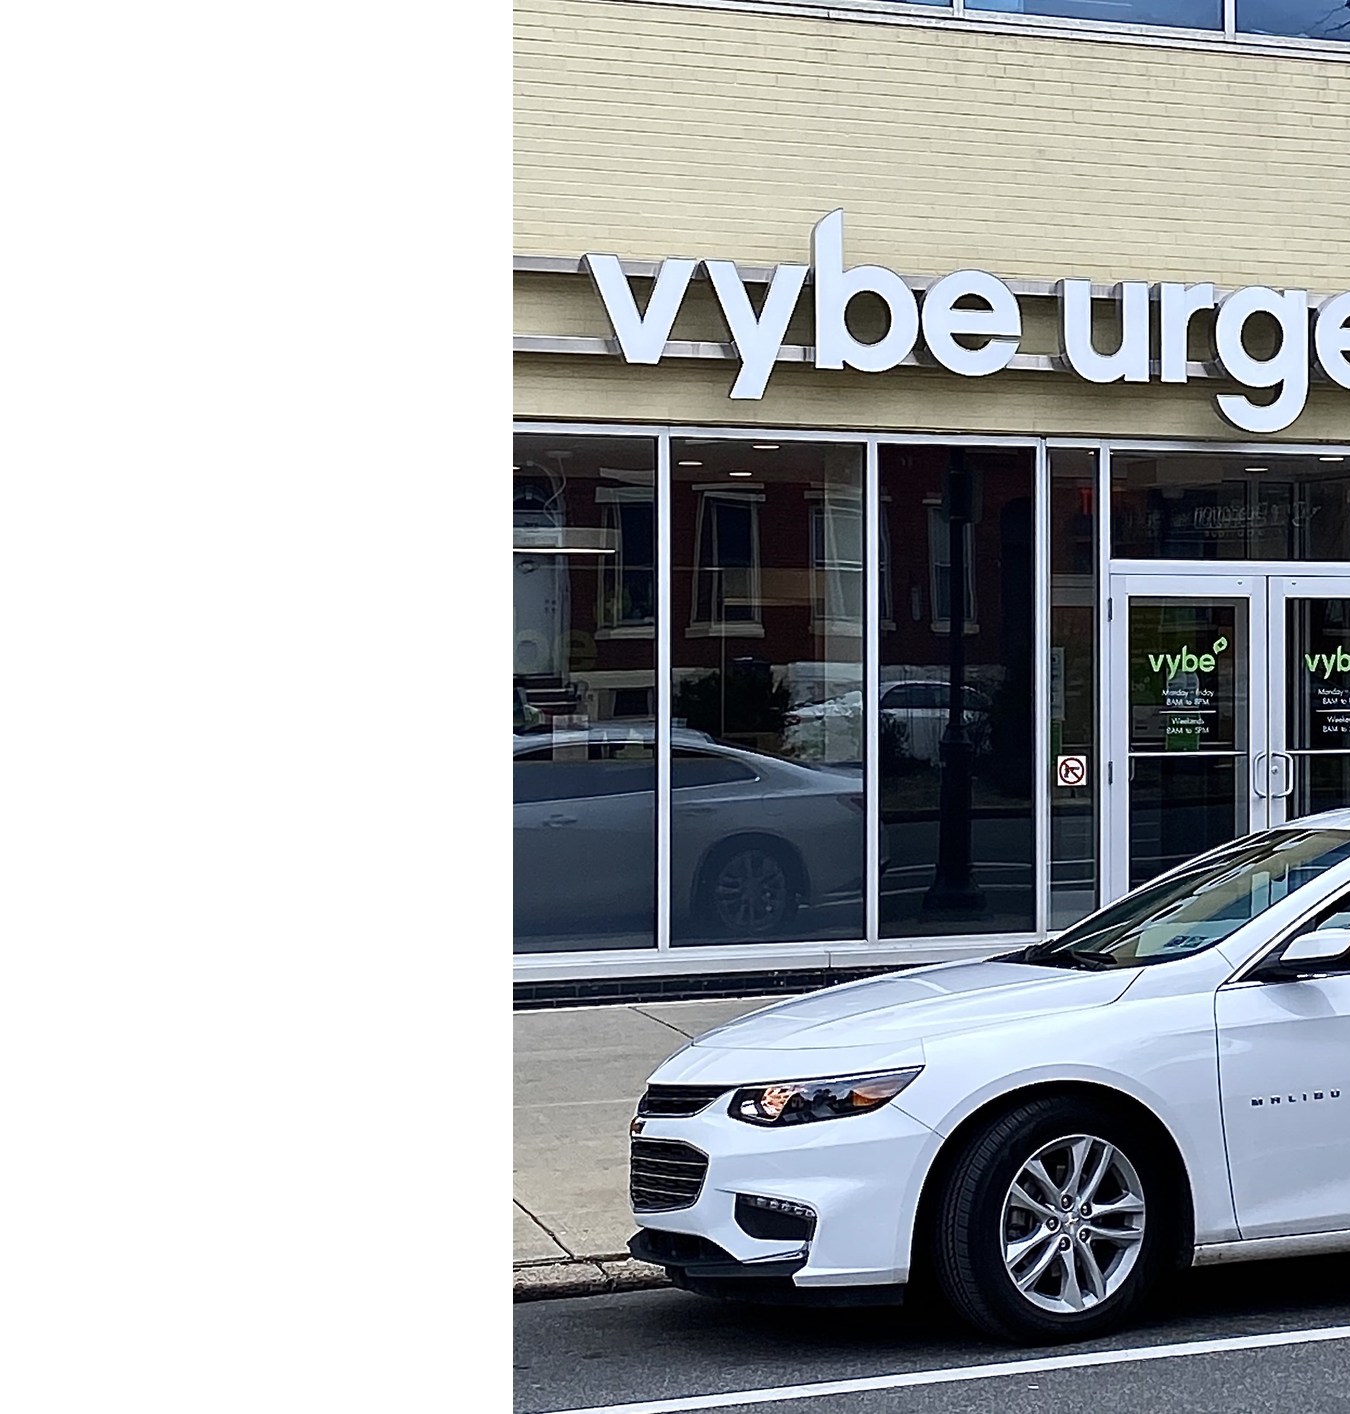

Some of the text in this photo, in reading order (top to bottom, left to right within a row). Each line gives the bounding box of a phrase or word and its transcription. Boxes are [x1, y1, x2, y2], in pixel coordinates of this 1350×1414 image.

[581, 207, 1022, 400] vybe
[1147, 644, 1216, 681] vybe
[1317, 687, 1344, 697] Monday
[1250, 1088, 1341, 1107] MALIBU
